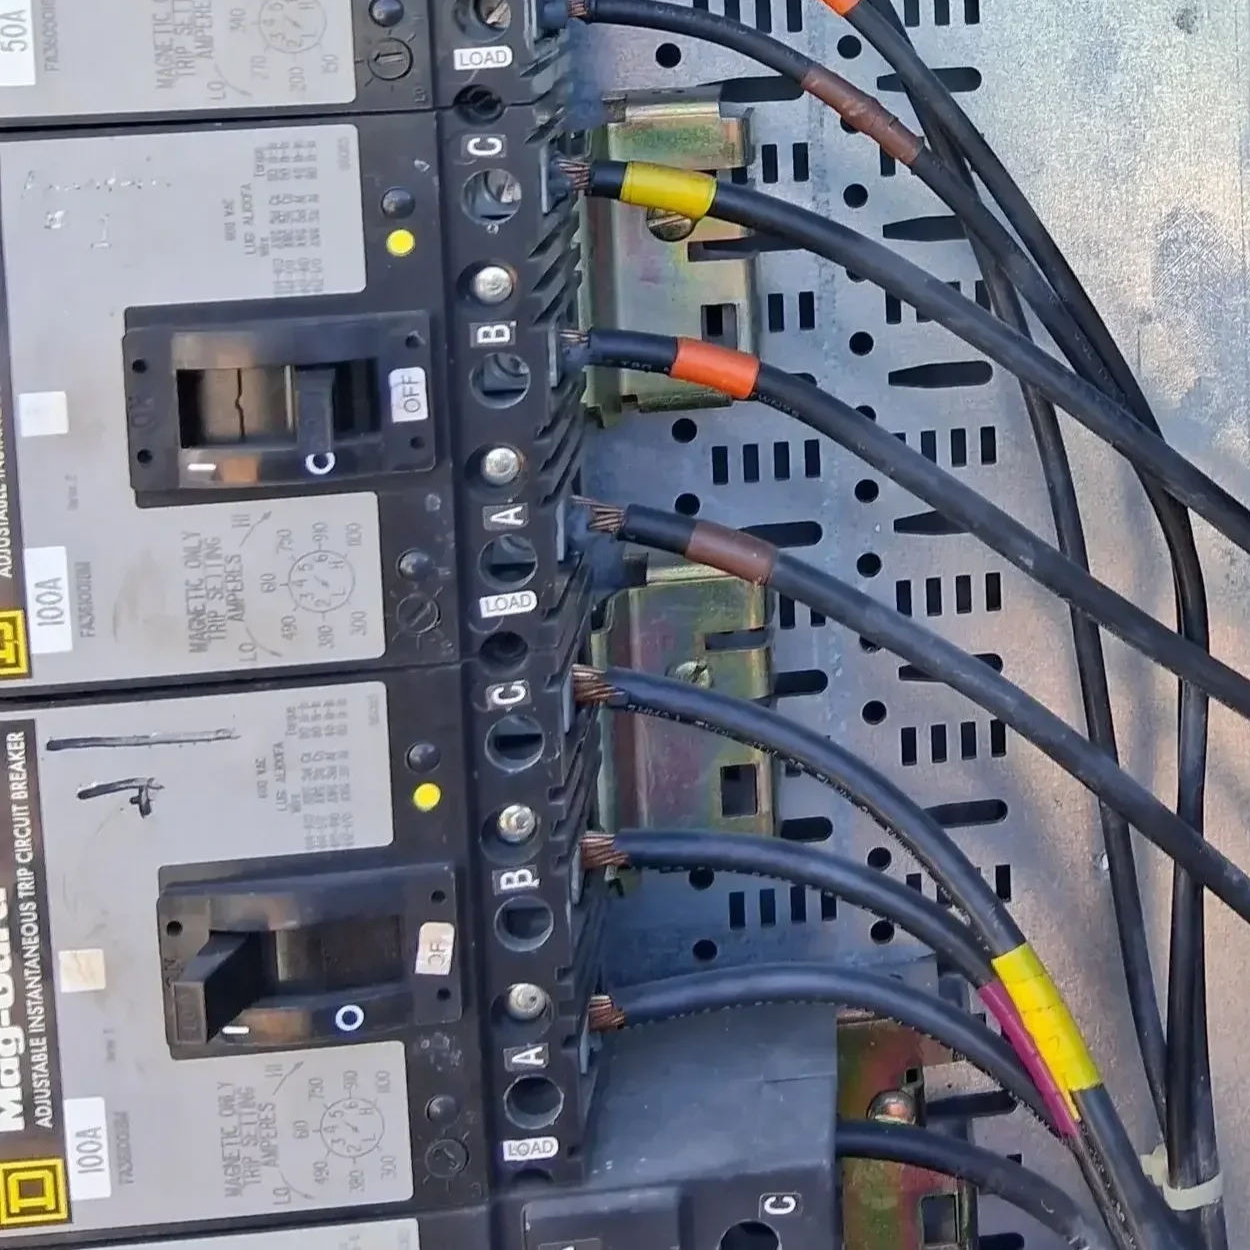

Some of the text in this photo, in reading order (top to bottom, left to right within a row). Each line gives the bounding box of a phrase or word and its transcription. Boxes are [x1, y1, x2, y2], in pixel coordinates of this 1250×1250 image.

[1, 9, 27, 52] 50A
[152, 12, 175, 89] MAGNETIC
[460, 49, 507, 67] LOAD
[467, 137, 502, 156] C
[477, 324, 511, 343] B
[402, 376, 421, 414] OFF
[231, 514, 250, 529] HI
[490, 505, 523, 526] A
[181, 530, 209, 653] MAGNETIC ONLY
[204, 537, 227, 641] TRIP SETTING
[224, 554, 245, 622] AMPERES
[260, 573, 276, 593] 610
[35, 577, 64, 627] 100A
[485, 593, 532, 613] LOAD
[239, 643, 257, 662] LO
[492, 685, 526, 705] C
[500, 868, 535, 889] B
[6, 731, 53, 1129] ADJUSTABLE INSTANTANEOUS TRIP CIRCUIT BREAKER
[512, 1046, 544, 1065] A
[217, 1082, 240, 1198] MAGNETIC ONLY
[238, 1087, 261, 1186] TRIP SETTING
[259, 1102, 279, 1167] AMPERES
[75, 1126, 105, 1174] 100A
[508, 1139, 554, 1156] LOAD
[273, 1187, 291, 1205] LO
[765, 1196, 796, 1215] C
